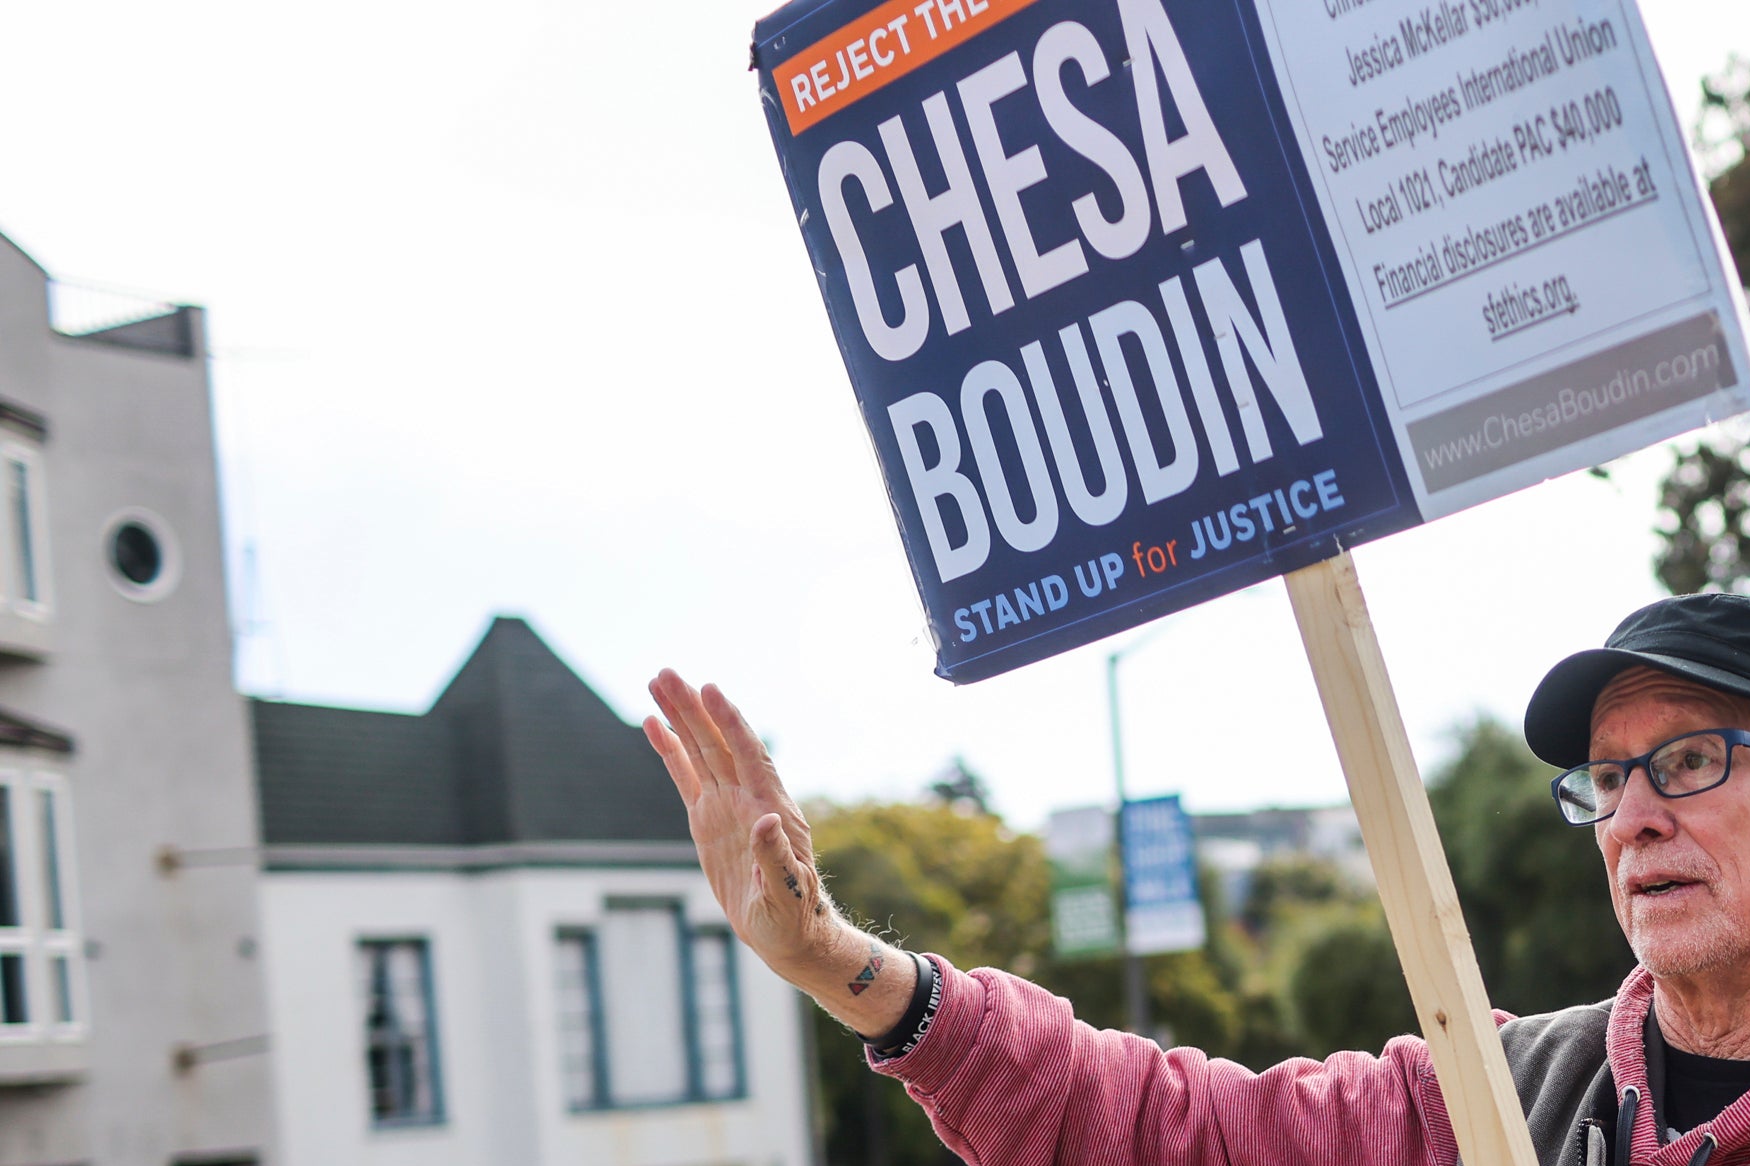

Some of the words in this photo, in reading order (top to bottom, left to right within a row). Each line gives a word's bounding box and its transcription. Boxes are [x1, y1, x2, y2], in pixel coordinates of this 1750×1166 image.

[791, 14, 911, 113] REJECT
[1322, 120, 1380, 174] Service
[1375, 85, 1462, 148] Employees
[1457, 29, 1560, 111] International
[1553, 16, 1618, 66] Union
[1345, 33, 1404, 87] Jessica
[1399, 0, 1470, 59] McKellar
[818, 0, 1248, 361] CHESA
[1355, 182, 1404, 235] Local
[1399, 165, 1444, 217] 1021,
[1438, 136, 1518, 198] Candidate
[1513, 114, 1553, 165] PAC
[1550, 85, 1623, 149] $40,000
[1372, 241, 1445, 302] Financial
[1443, 211, 1529, 275] disclosures
[1527, 204, 1555, 239] are
[1554, 164, 1632, 227] available
[1632, 152, 1657, 196] at
[887, 238, 1324, 584] BOUDIN
[1424, 343, 1719, 470] www.ChesaBoudin.com
[953, 573, 1069, 643] STAND
[1074, 552, 1125, 598] UP
[1132, 539, 1178, 578] for
[1190, 470, 1346, 560] JUSTICE
[902, 1012, 934, 1053] BLACK
